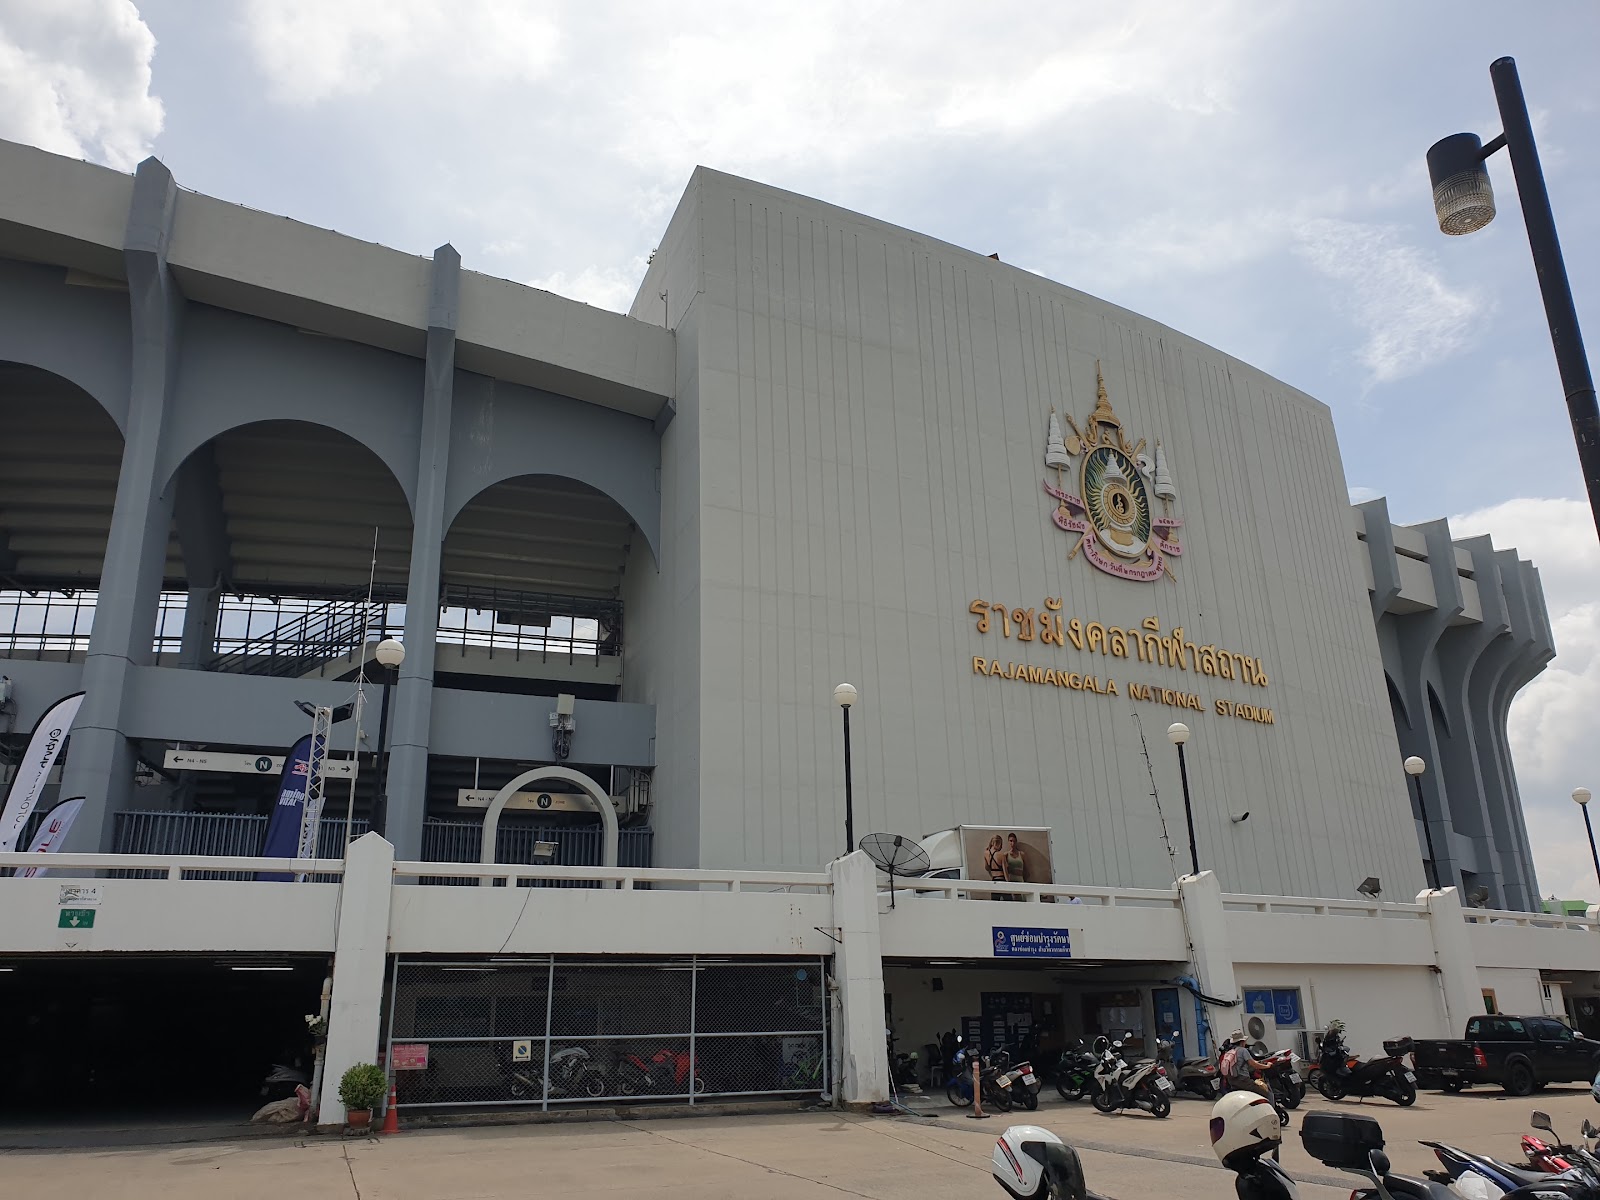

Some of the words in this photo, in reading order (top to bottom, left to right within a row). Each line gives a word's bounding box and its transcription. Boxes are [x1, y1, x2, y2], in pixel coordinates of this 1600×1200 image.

[969, 596, 1269, 687] ราชมังคลากีฬาสถาน
[972, 656, 1119, 696] RAJAMANGALA
[1128, 682, 1206, 711] NATIONAL
[1214, 698, 1275, 724] STADIUM
[259, 760, 269, 770] N
